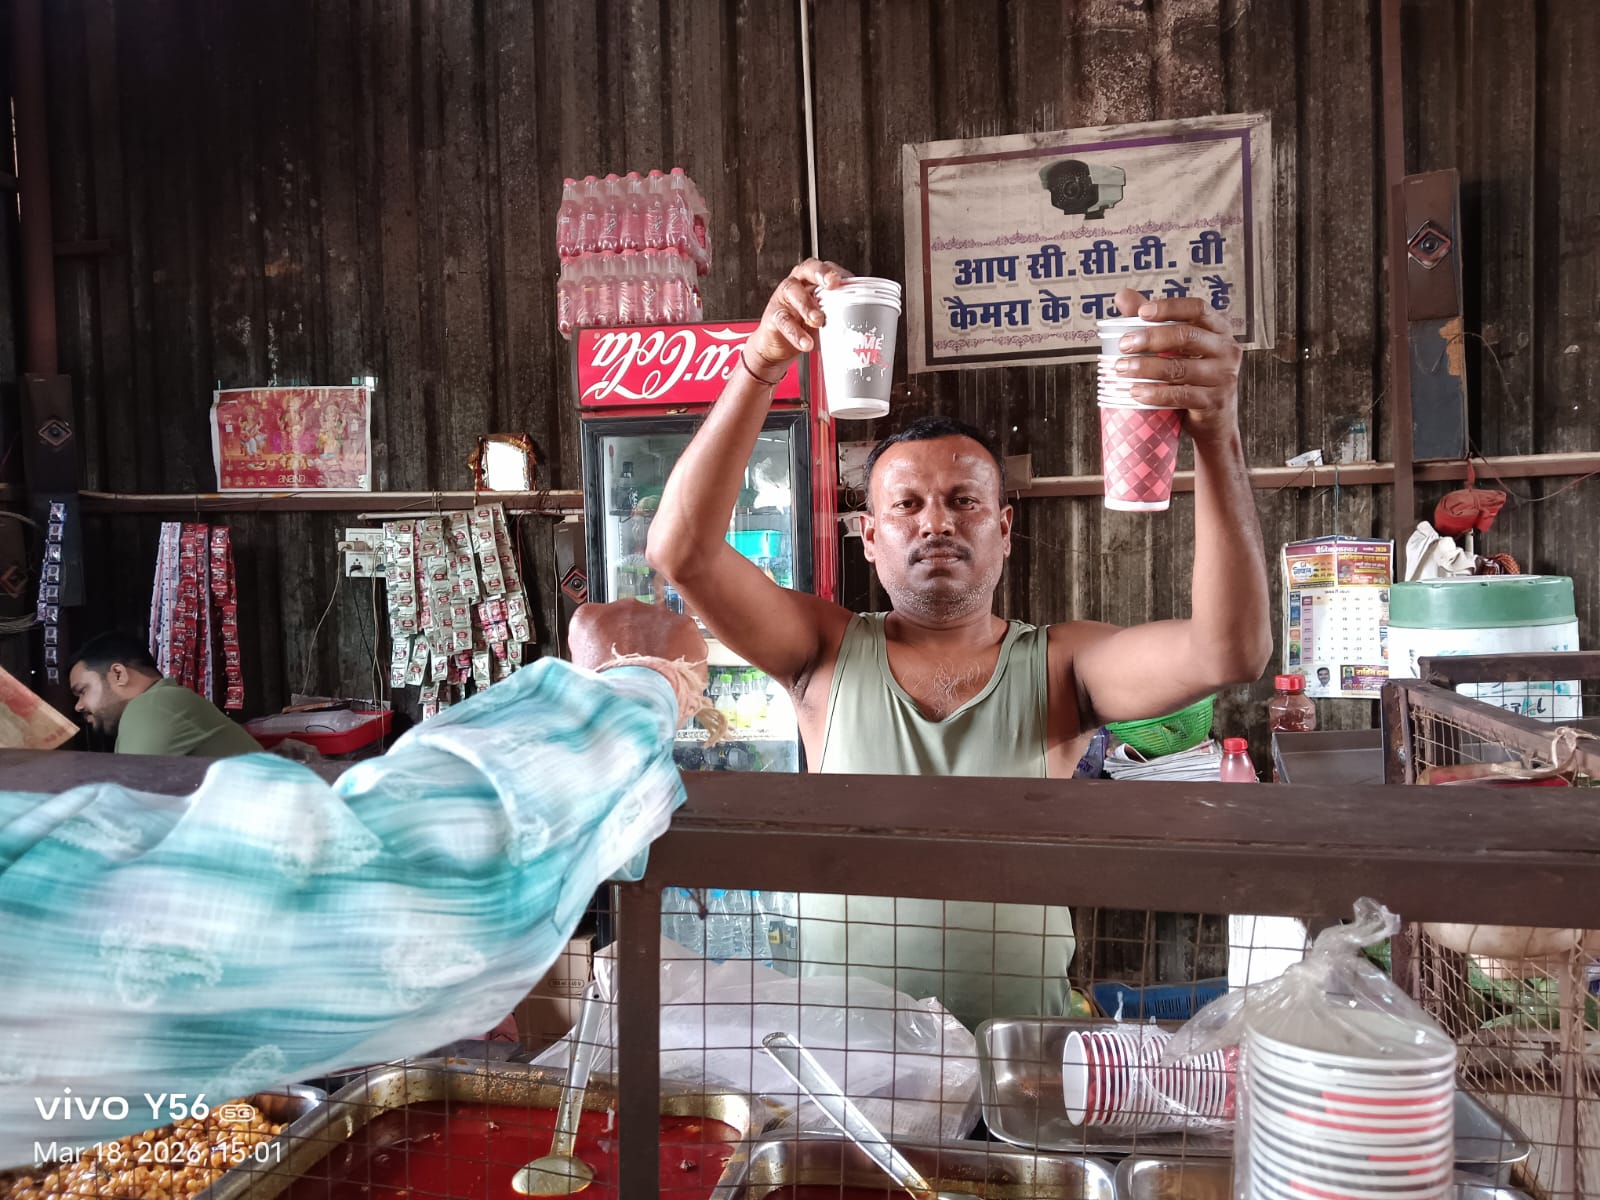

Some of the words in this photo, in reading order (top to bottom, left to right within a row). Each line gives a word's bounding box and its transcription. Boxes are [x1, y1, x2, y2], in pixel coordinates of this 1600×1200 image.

[955, 255, 1020, 286] आप
[943, 295, 1032, 330] कैमरा
[1038, 289, 1072, 324] के
[1202, 274, 1234, 311] है
[581, 328, 752, 400] ca-Cola
